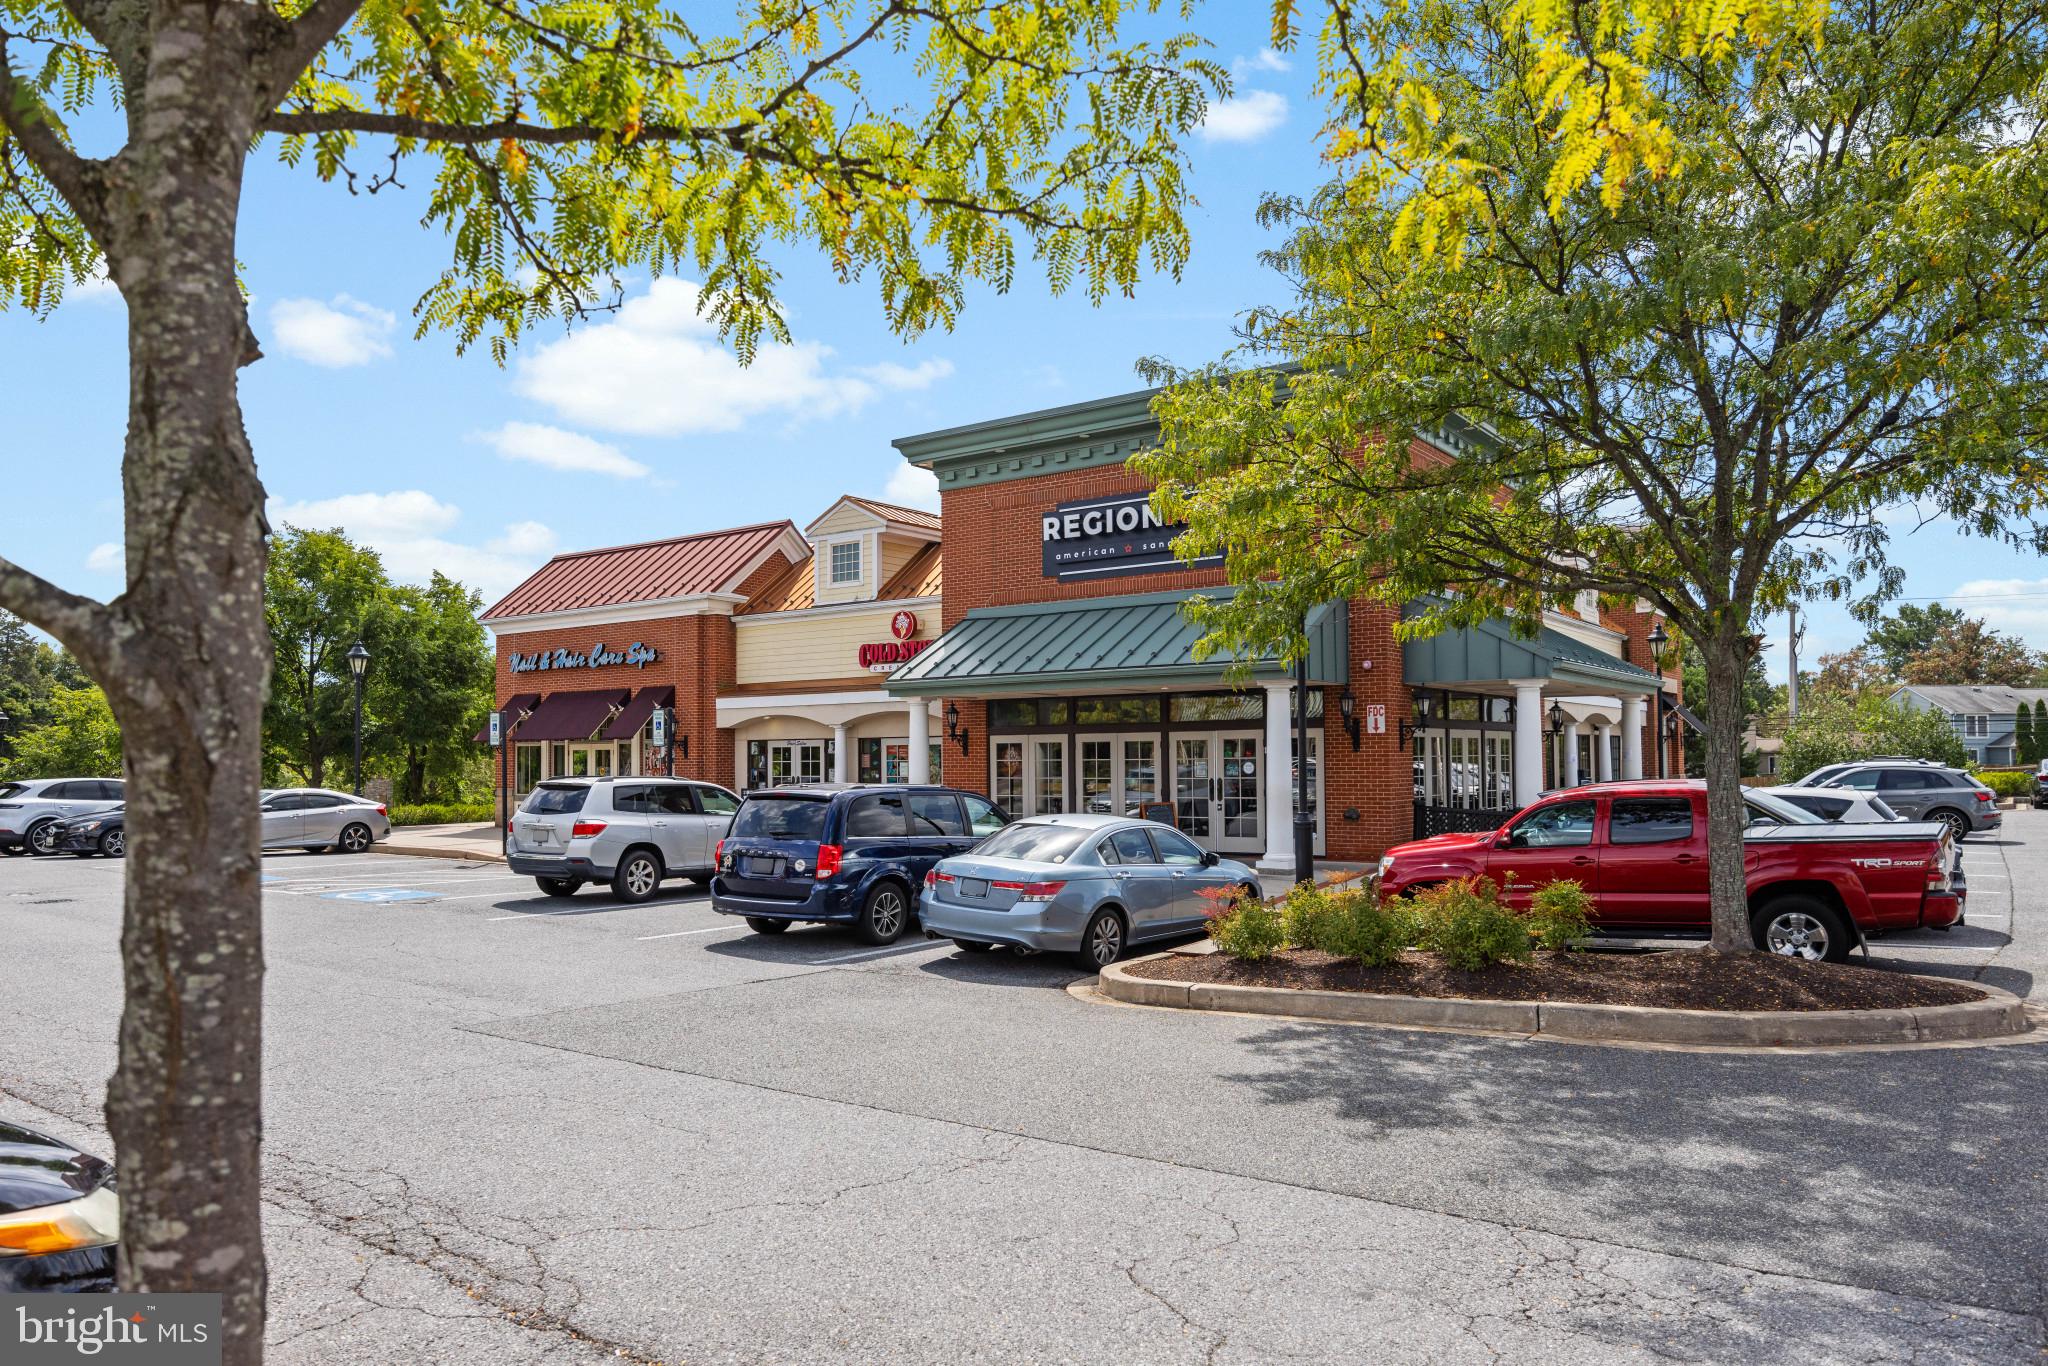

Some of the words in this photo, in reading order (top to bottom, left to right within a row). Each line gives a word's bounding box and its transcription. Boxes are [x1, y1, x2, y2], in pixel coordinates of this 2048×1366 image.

[1043, 503, 1188, 541] REGION
[1055, 547, 1115, 560] american
[509, 652, 537, 672] Nail
[539, 651, 550, 670] &
[552, 648, 586, 668] Hair
[588, 642, 624, 668] Care
[626, 641, 656, 669] Spa
[859, 643, 900, 668] COLD
[899, 640, 934, 661] STO
[1368, 706, 1384, 717] FDC
[1851, 858, 1892, 868] TRD
